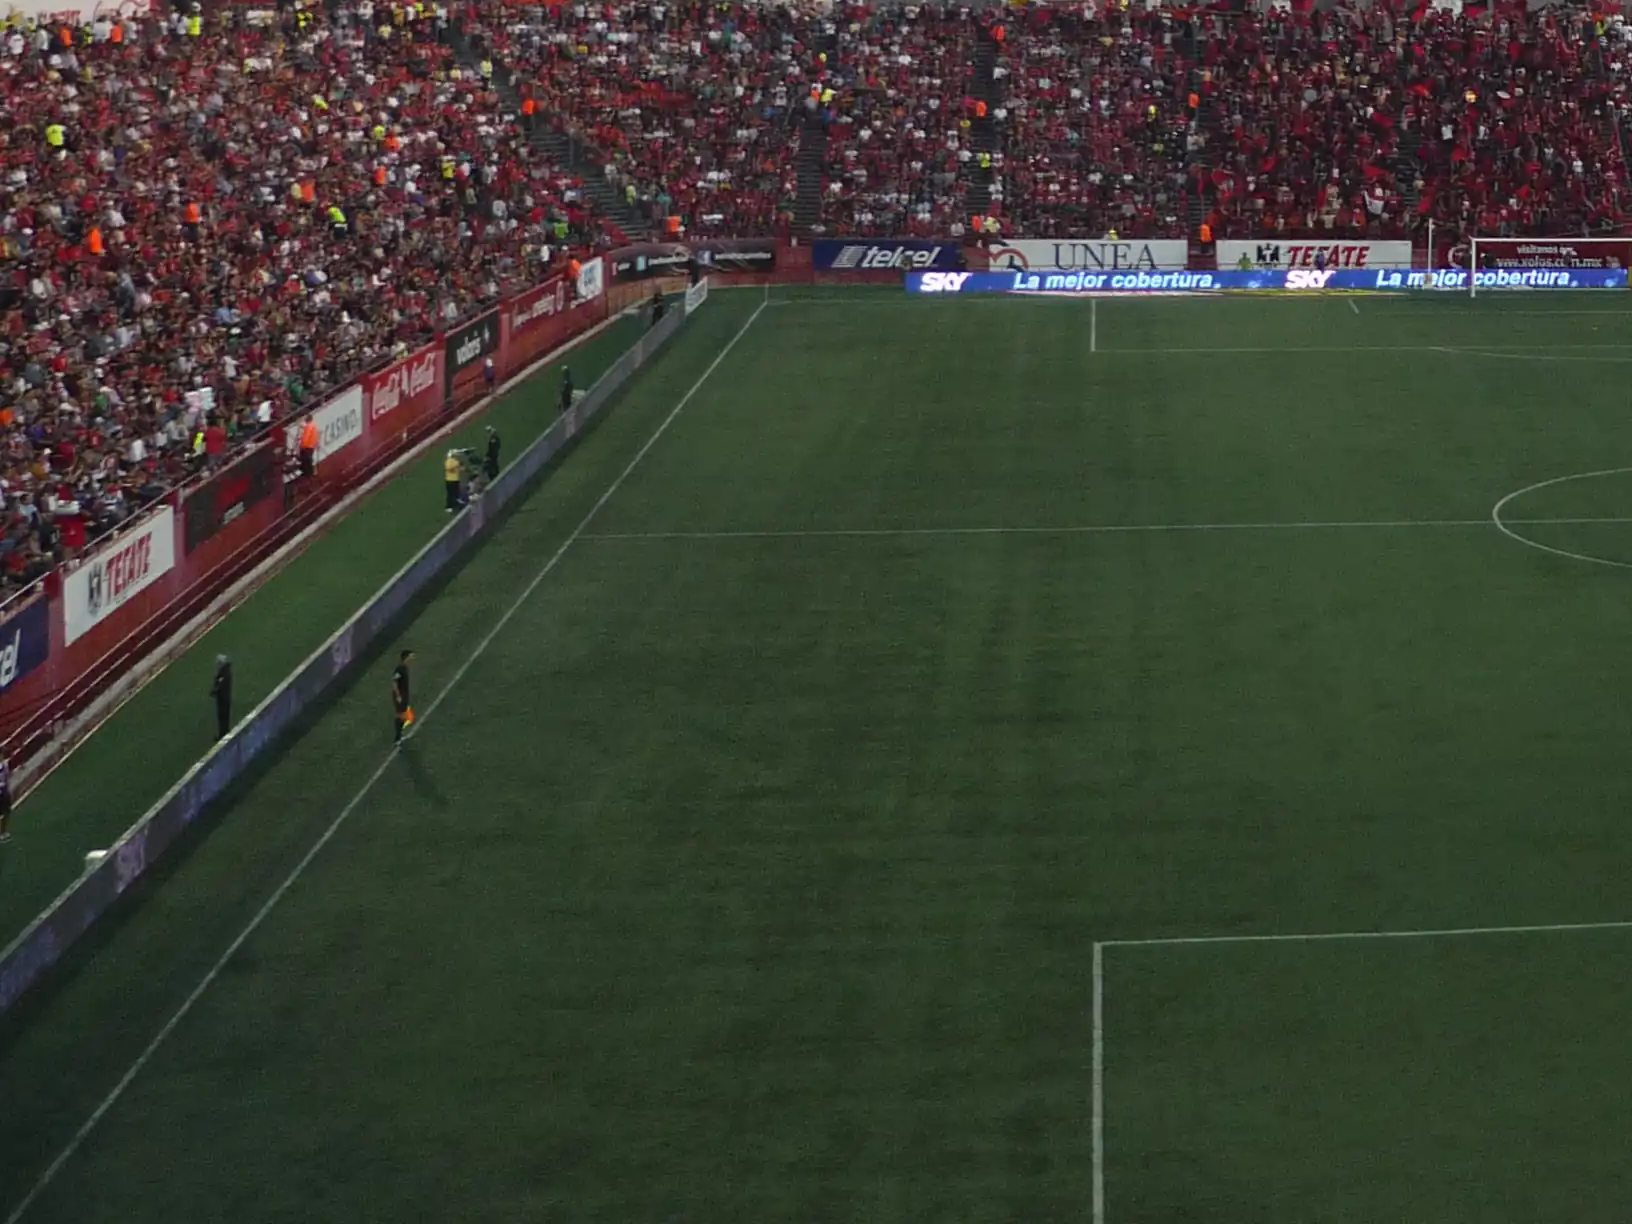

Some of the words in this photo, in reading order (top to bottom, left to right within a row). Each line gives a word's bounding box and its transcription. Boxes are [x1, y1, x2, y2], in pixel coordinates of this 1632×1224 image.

[861, 246, 942, 268] telcel
[1052, 243, 1158, 270] UNEA
[1288, 245, 1370, 266] TECATE
[920, 272, 973, 292] SKY
[1014, 272, 1040, 289] La
[1046, 272, 1107, 291] mejor
[1111, 272, 1222, 289] cobertura.
[1285, 270, 1336, 289] SKY
[1376, 270, 1400, 286] La
[1407, 271, 1467, 287] mjor
[1473, 269, 1579, 287] cobertura.
[324, 409, 357, 445] CASINO
[107, 531, 152, 598] TECATE
[0, 628, 21, 688] el
